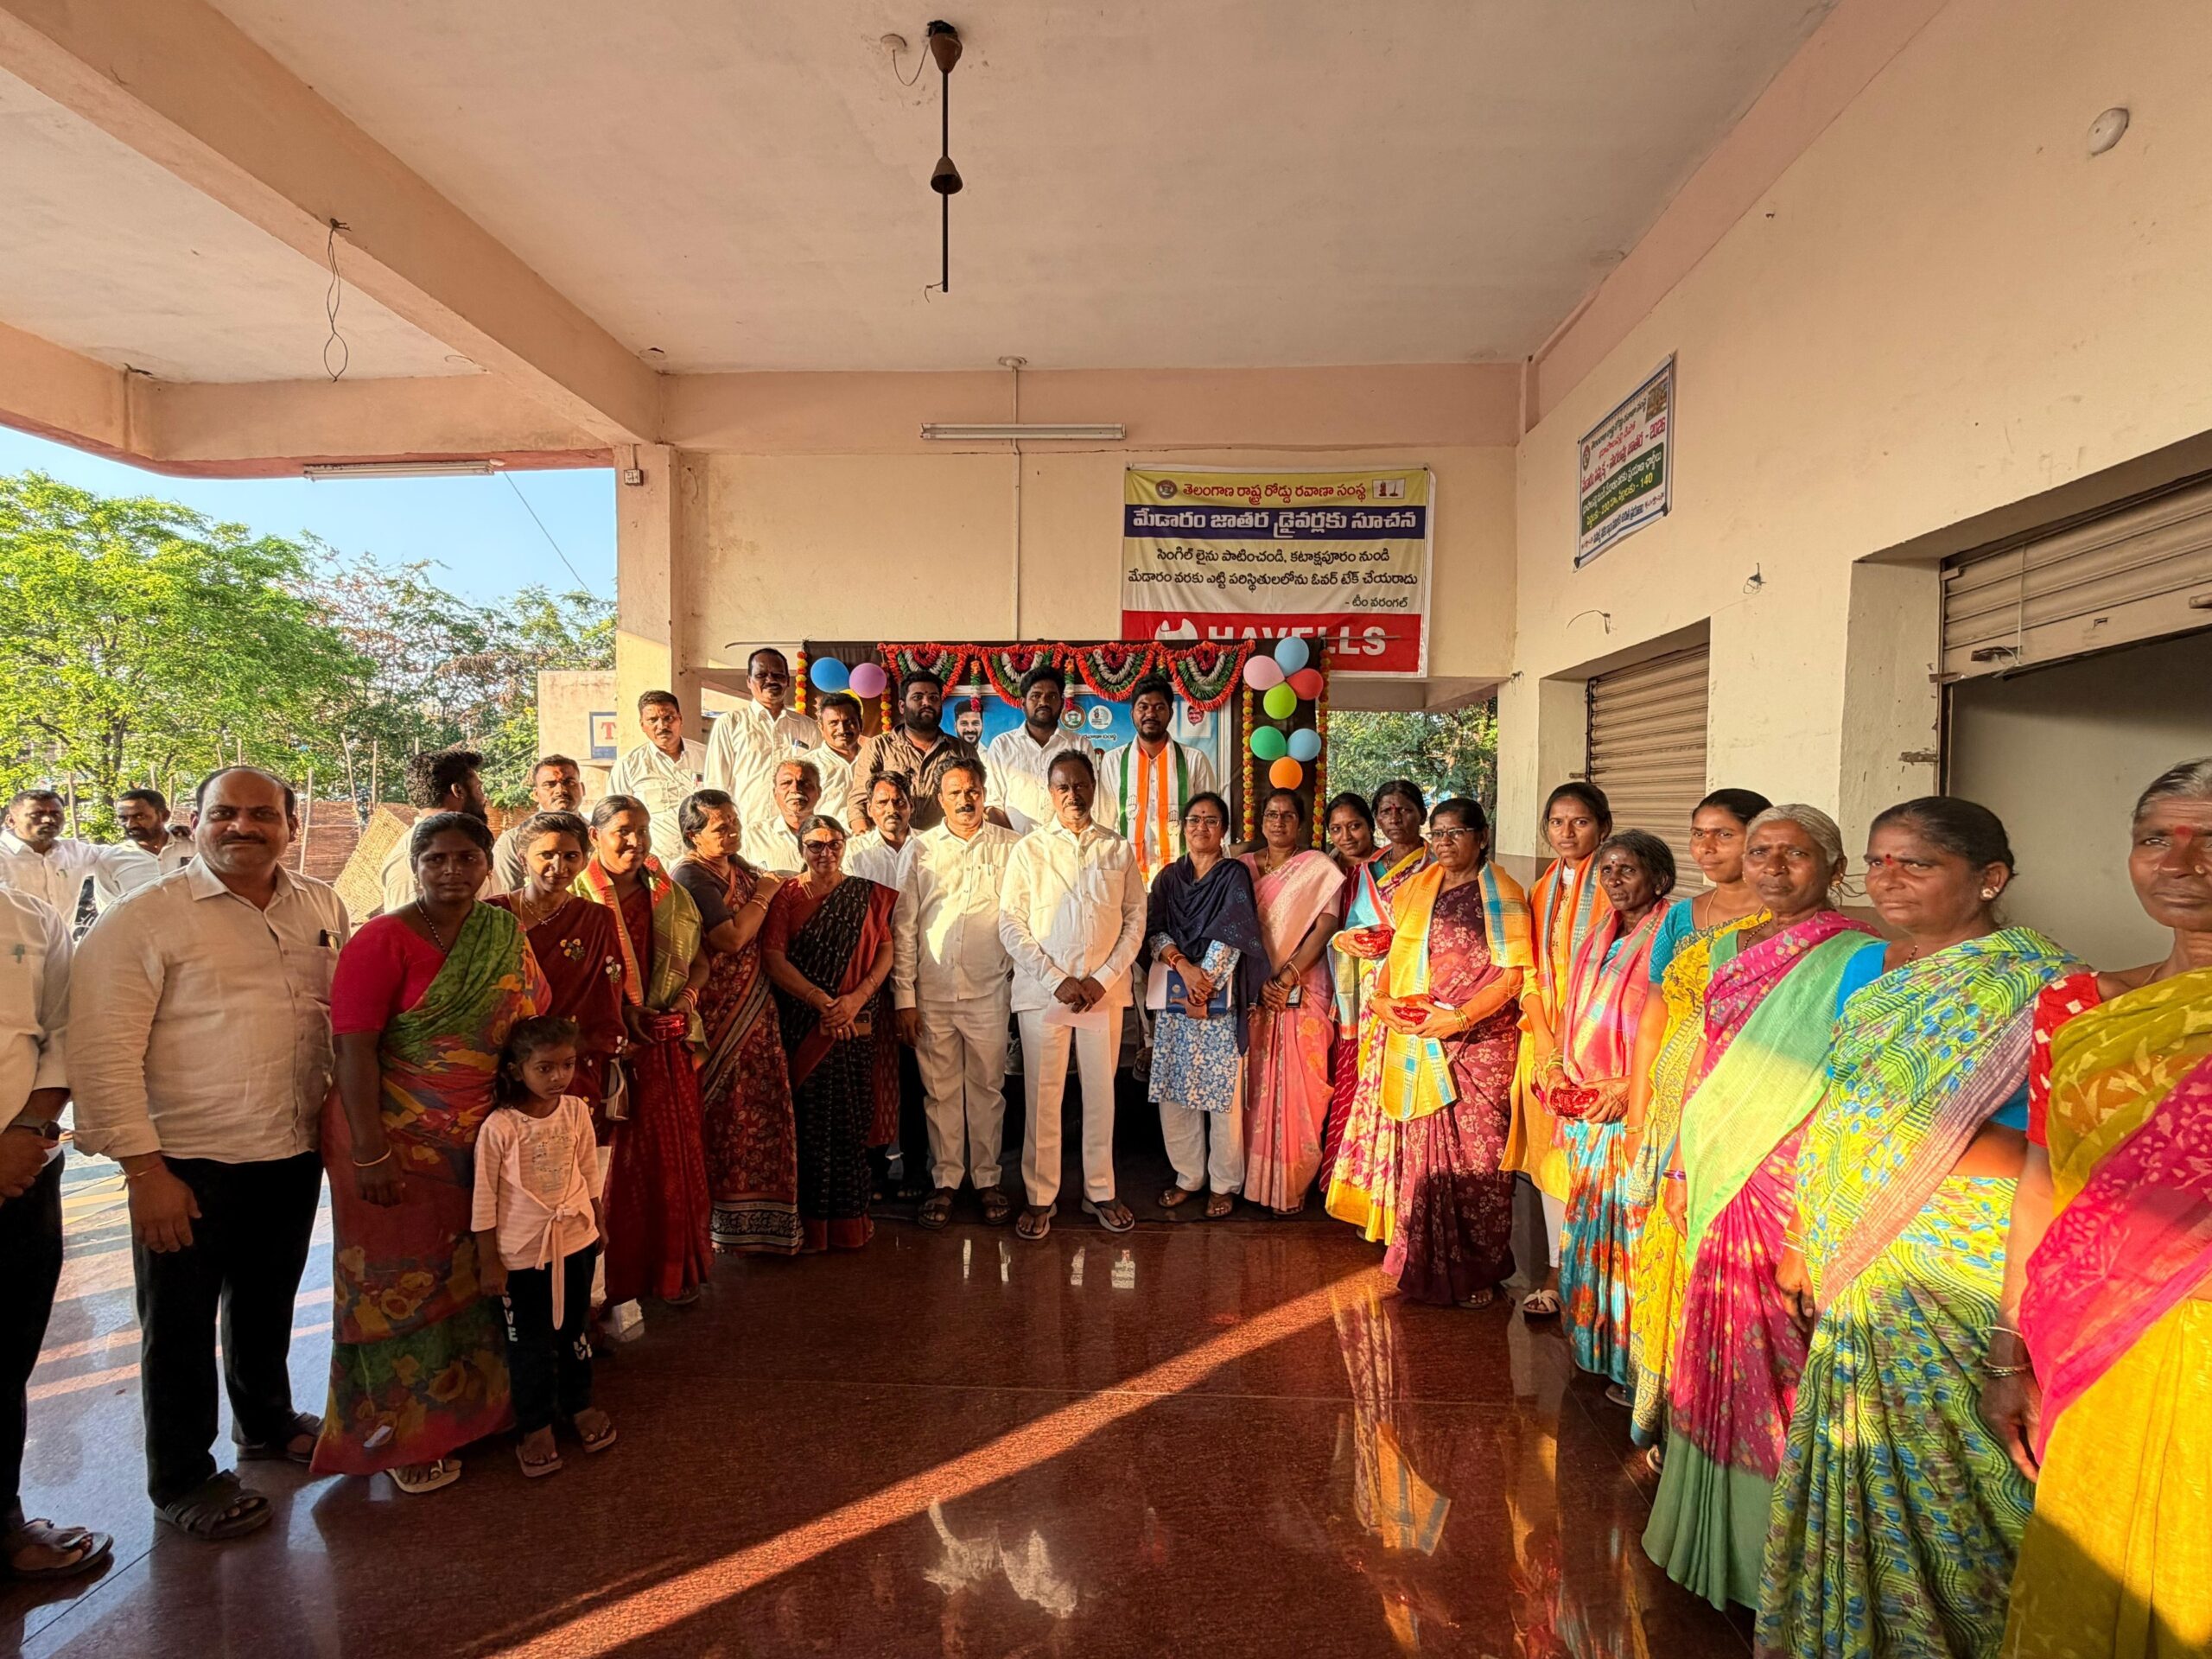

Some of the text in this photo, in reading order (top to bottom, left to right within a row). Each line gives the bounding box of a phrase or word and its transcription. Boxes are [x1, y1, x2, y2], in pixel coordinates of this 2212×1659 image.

[1640, 471, 1653, 488] 140
[1183, 483, 1234, 498] తెలంగాణ
[1236, 483, 1262, 505] రాష్ట్ర
[1264, 483, 1293, 504] రోడ్డు
[1295, 485, 1334, 498] రవాణా
[1337, 483, 1367, 503] సంస్థ
[1133, 508, 1416, 538] మేడారం జాతర డ్రైవర్లకు సూచన
[1157, 546, 1193, 561] సింగిల్
[1196, 549, 1218, 565] లైను
[1290, 550, 1356, 567] కటాక్షపూరం
[1359, 547, 1389, 562] నుండి
[1128, 568, 1172, 583] మేడారం
[1174, 571, 1204, 584] వరకు
[1311, 571, 1338, 585] ఓవర్
[1340, 570, 1359, 585] టేక్
[1362, 569, 1418, 585] చేయరాదు
[1351, 594, 1369, 607] టీం
[1370, 596, 1408, 607] వరంగల్
[601, 721, 617, 740] T
